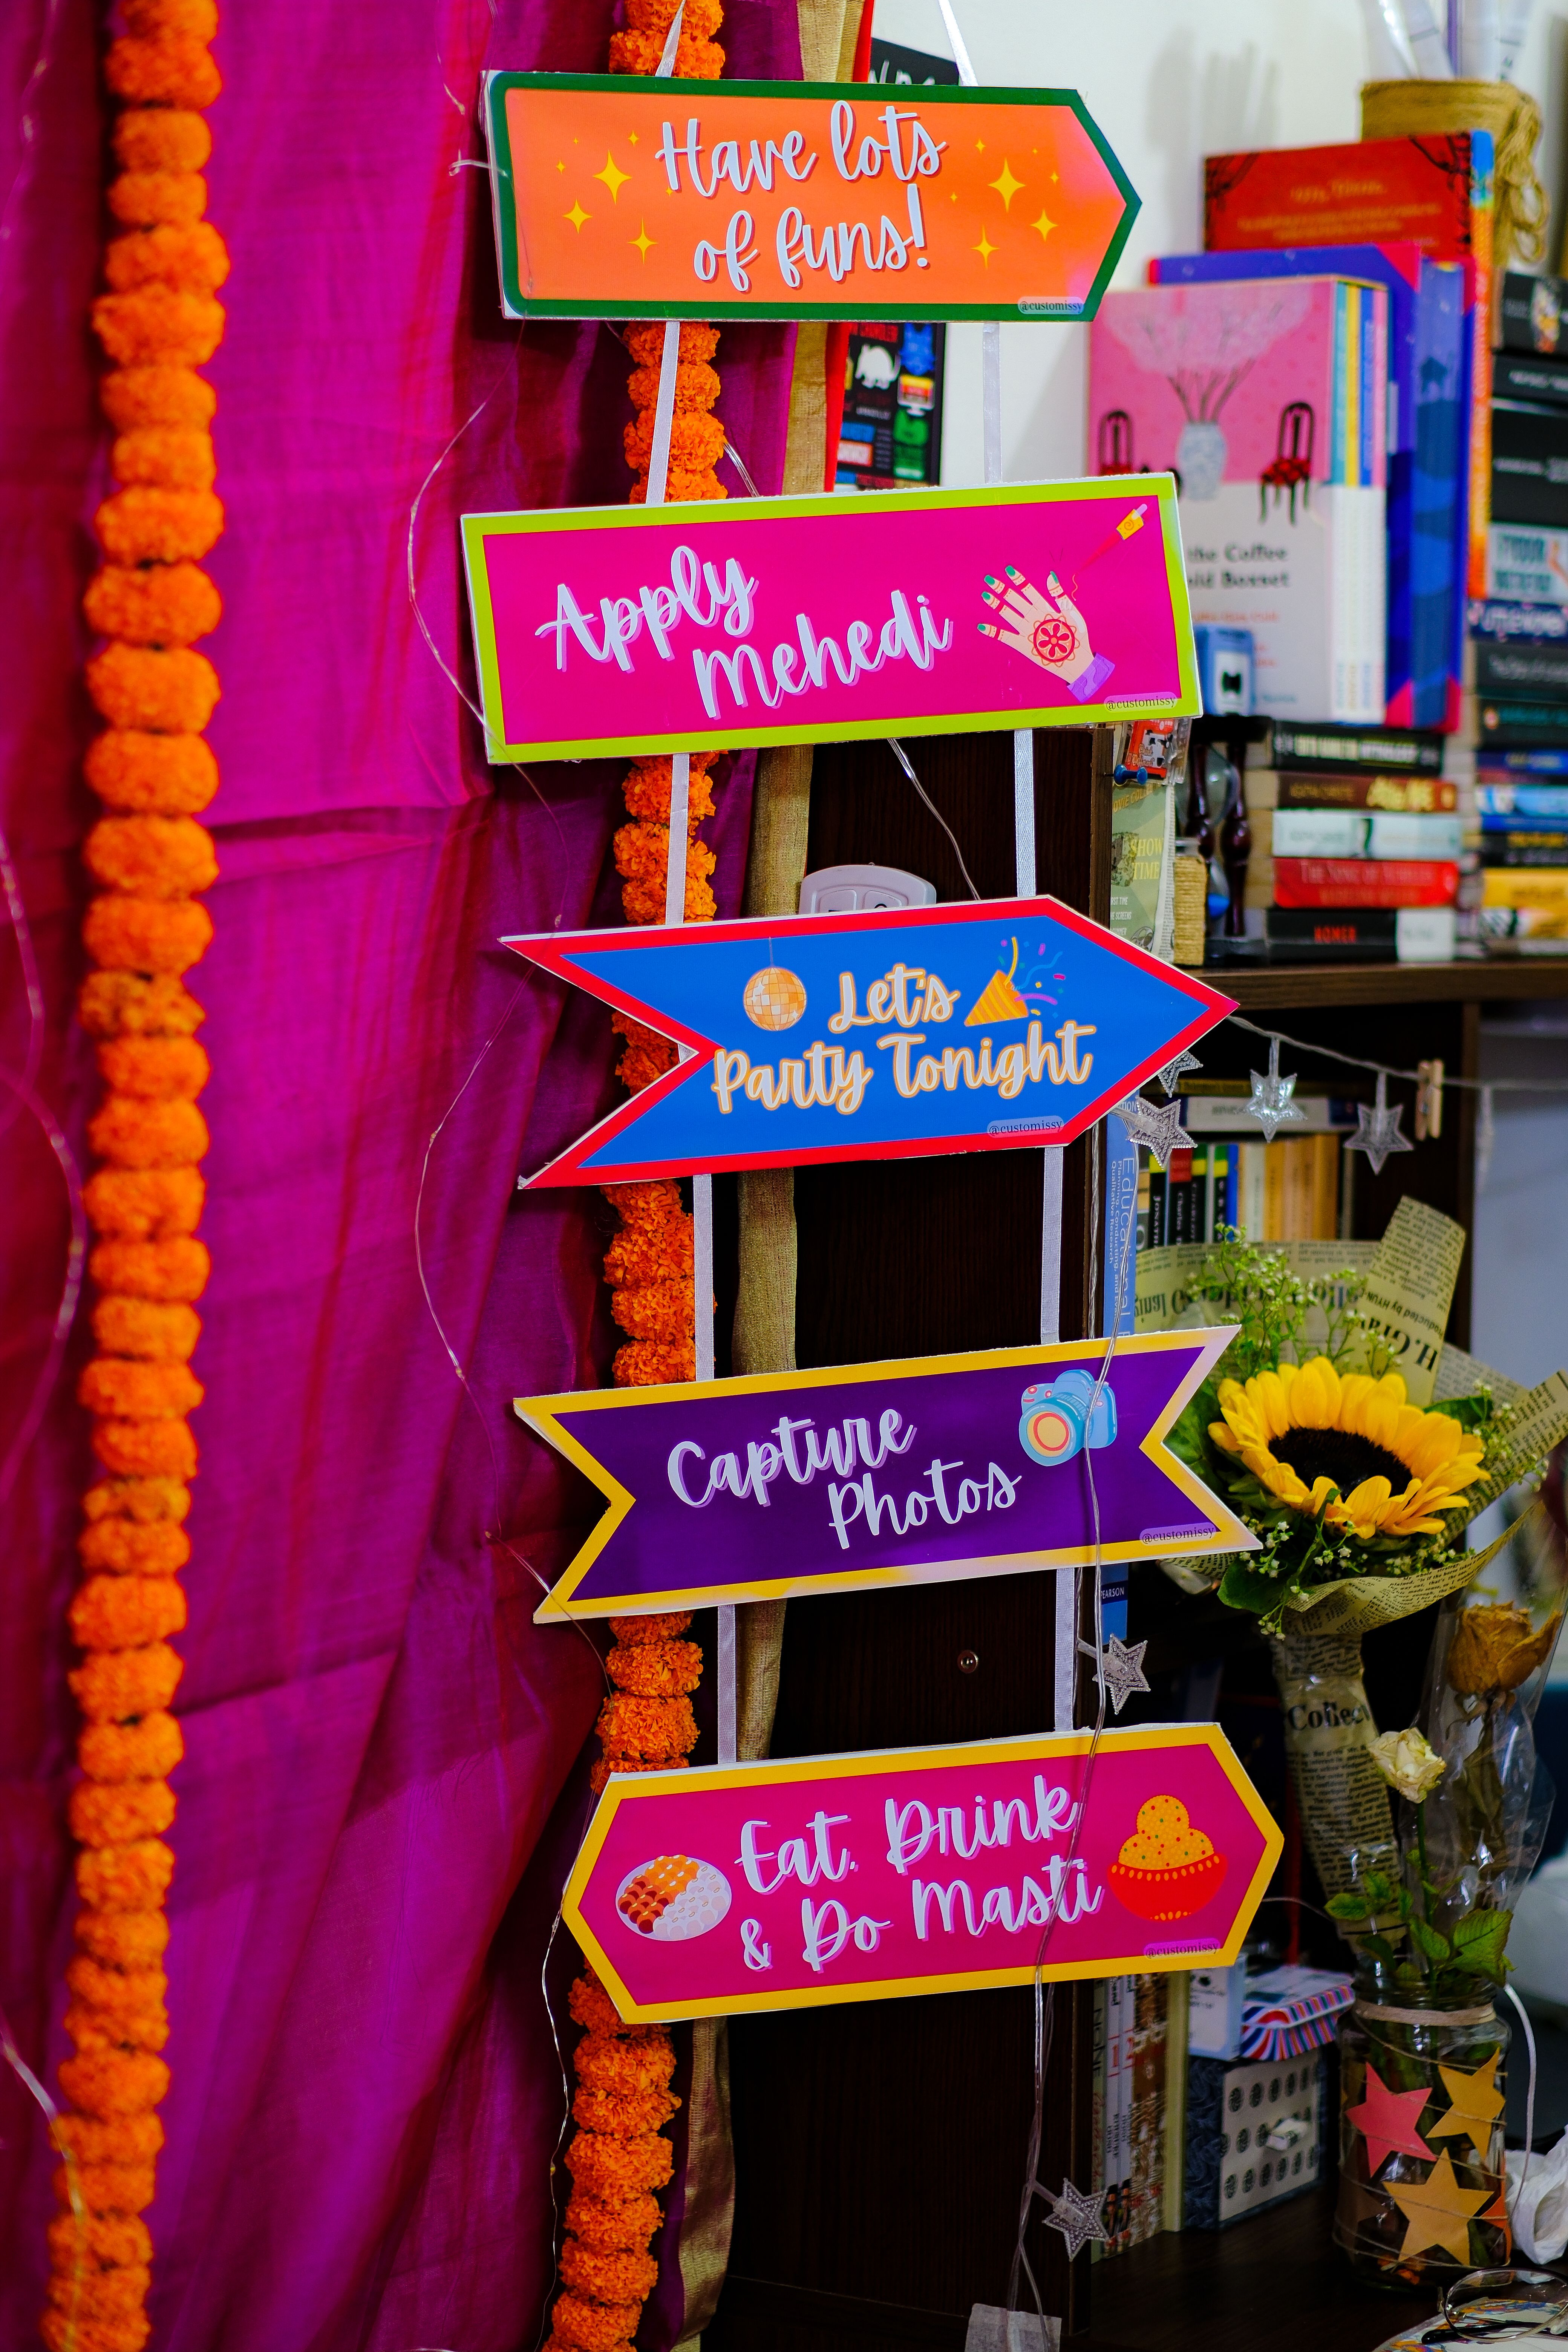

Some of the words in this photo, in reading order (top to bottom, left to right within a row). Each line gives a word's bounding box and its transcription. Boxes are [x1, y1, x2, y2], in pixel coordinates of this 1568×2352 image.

[655, 118, 817, 197] Have
[831, 100, 947, 181] lots
[694, 210, 758, 292] of
[776, 184, 929, 288] funs!
[1019, 300, 1083, 314] @customissy
[536, 545, 756, 672] Apply
[1106, 696, 1176, 712] @customissy
[1130, 838, 1164, 857] SHOW
[1132, 862, 1160, 880] TIME
[828, 963, 960, 1034] Let's
[877, 1020, 1097, 1100] Tonight
[989, 1120, 1062, 1137] @customissy
[667, 1409, 916, 1508] Capture
[828, 1459, 1022, 1550] Photos
[1141, 1525, 1215, 1545] @customissy
[884, 1774, 1079, 1874] Drink
[741, 1918, 772, 1972] &
[801, 1898, 891, 1972] Do
[912, 1854, 1105, 1940] Masti
[1143, 1939, 1219, 1958] @customissy
